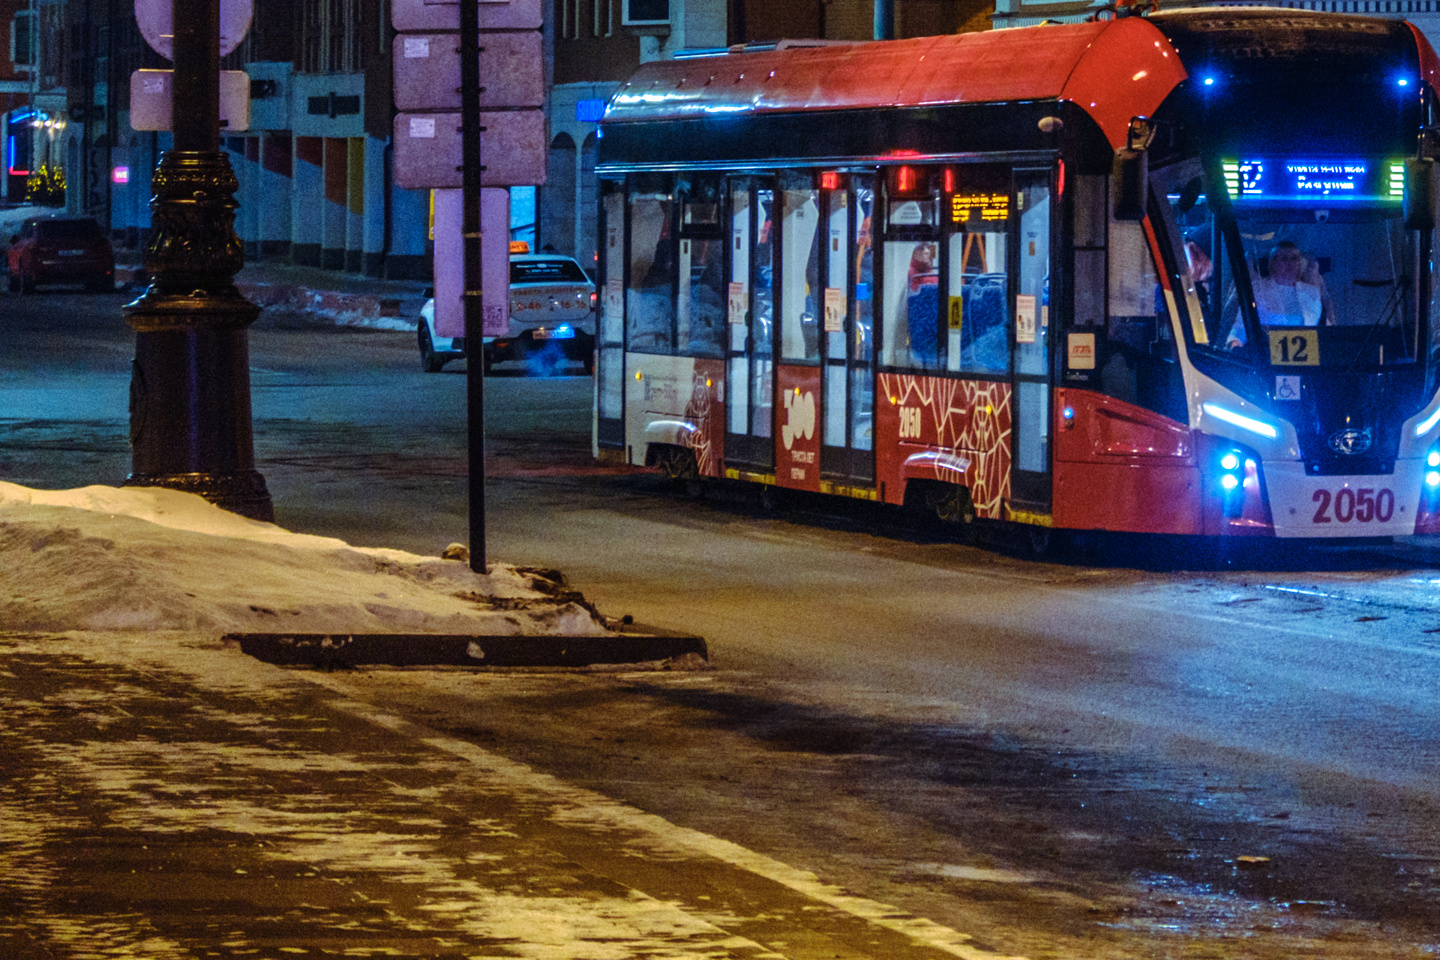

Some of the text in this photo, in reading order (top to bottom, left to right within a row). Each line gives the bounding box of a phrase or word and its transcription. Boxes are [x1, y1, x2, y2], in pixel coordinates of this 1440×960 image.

[1277, 335, 1308, 363] 12
[899, 406, 922, 439] 2050
[1312, 487, 1395, 524] 2050
